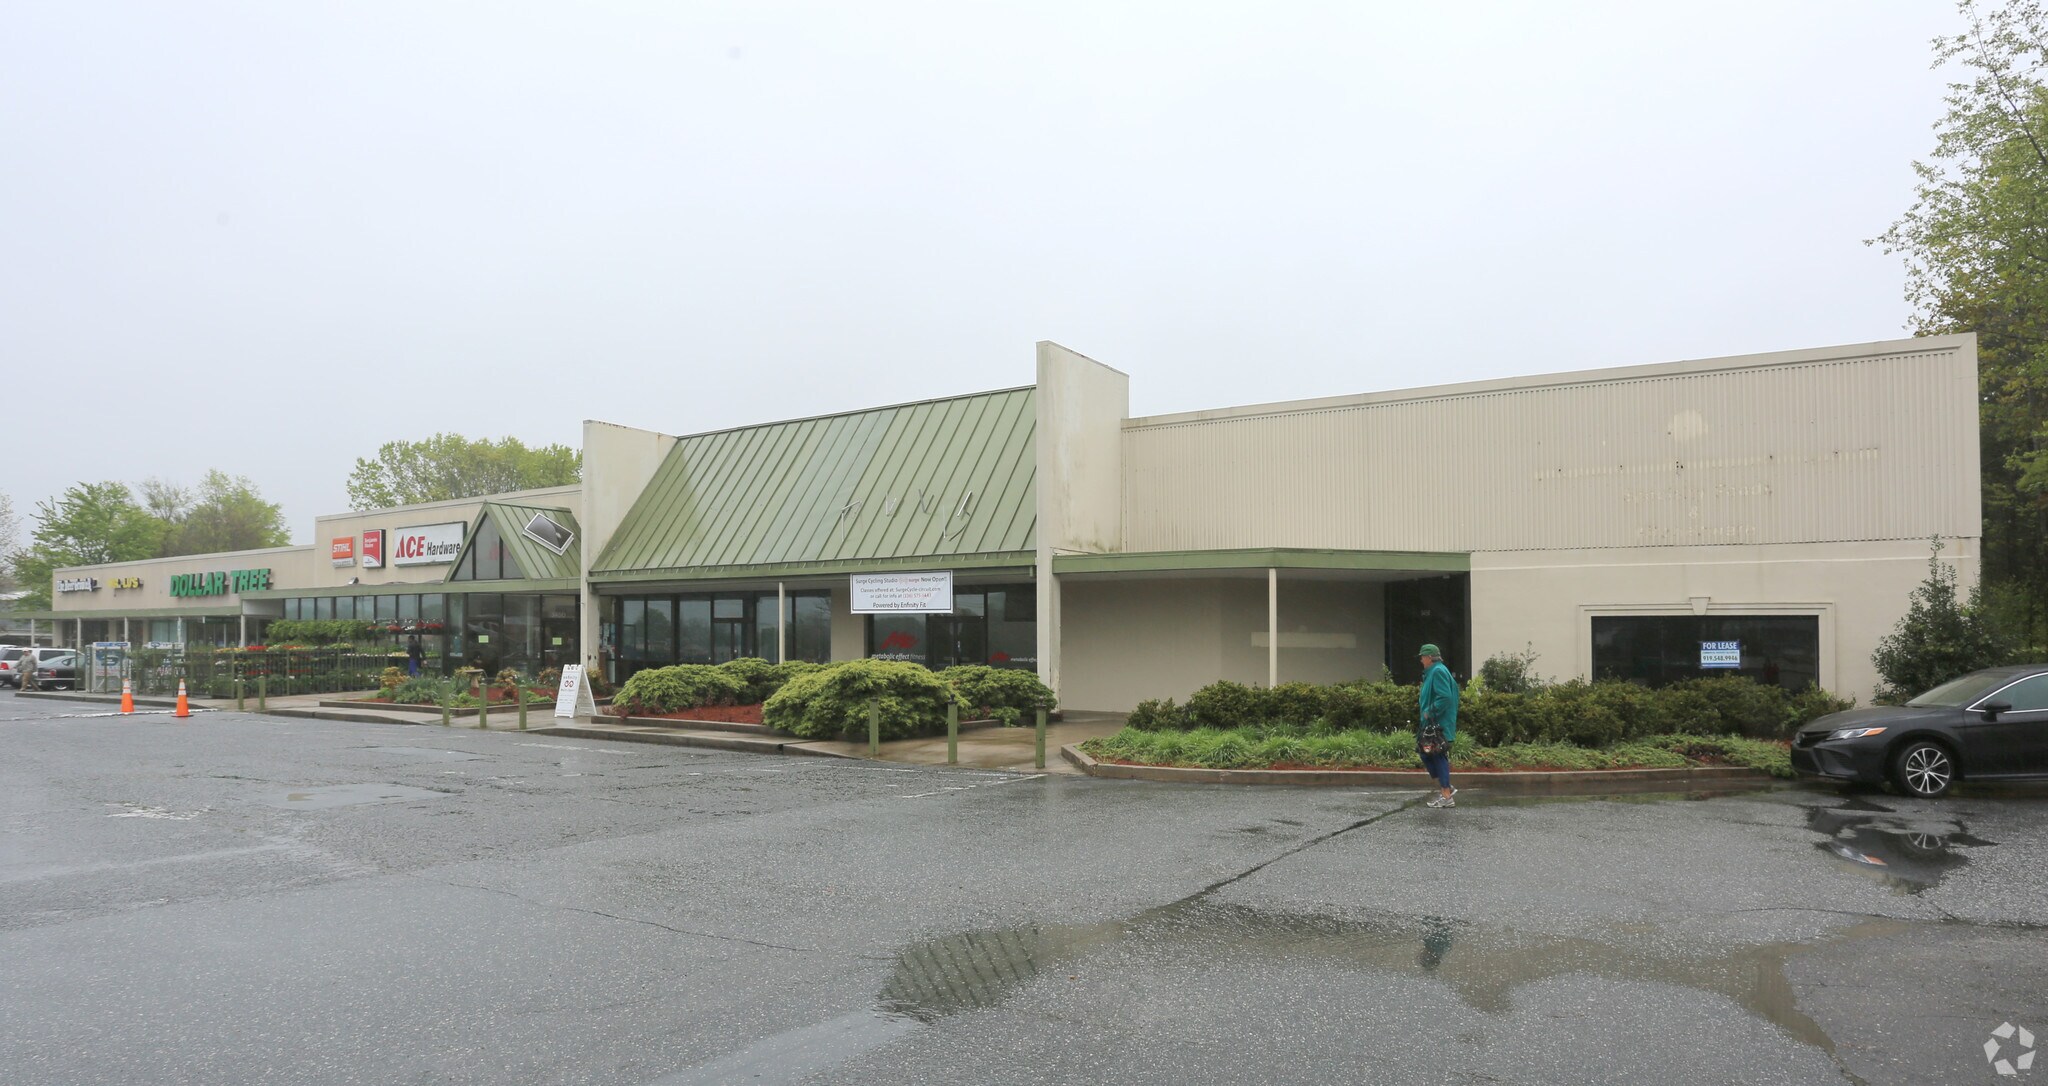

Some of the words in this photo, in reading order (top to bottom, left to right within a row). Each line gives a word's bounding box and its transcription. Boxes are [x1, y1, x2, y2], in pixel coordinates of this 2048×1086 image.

[332, 543, 351, 553] STIHL
[395, 534, 426, 558] ACE
[426, 541, 461, 556] Hardware
[169, 571, 226, 597] DOLLAR
[230, 568, 270, 594] TREE
[1702, 642, 1717, 650] FOR
[1717, 642, 1737, 650] LEASE
[872, 653, 895, 661] metabolic
[895, 653, 909, 661] effect
[909, 653, 926, 661] fitness
